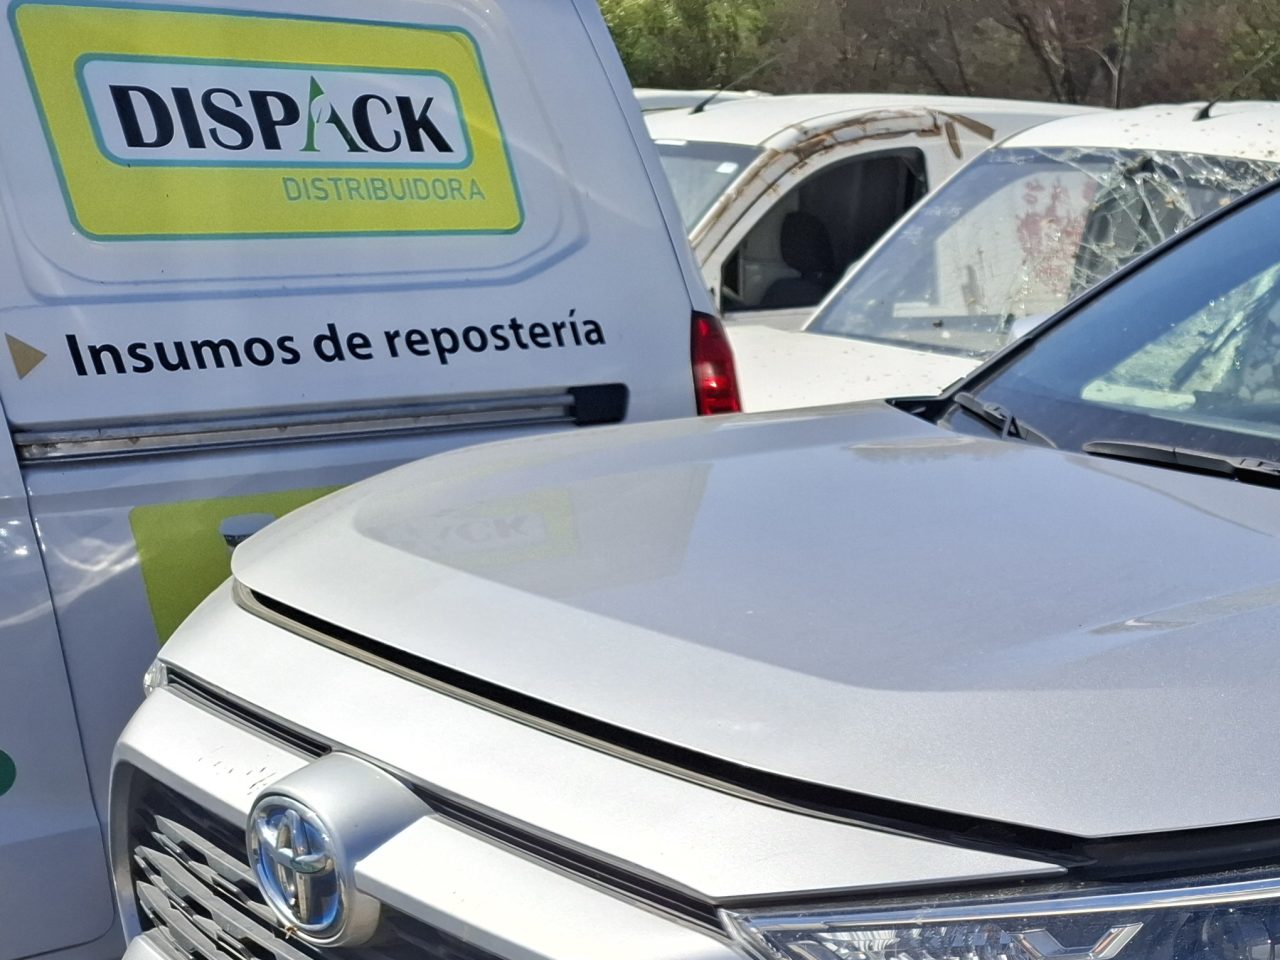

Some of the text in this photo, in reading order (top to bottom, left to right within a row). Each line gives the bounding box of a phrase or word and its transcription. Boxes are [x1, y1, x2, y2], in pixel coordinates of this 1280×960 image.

[109, 77, 453, 152] DISPACK
[283, 176, 485, 202] DISTRIBUIDORA
[66, 309, 605, 375] Insumos de repostería
